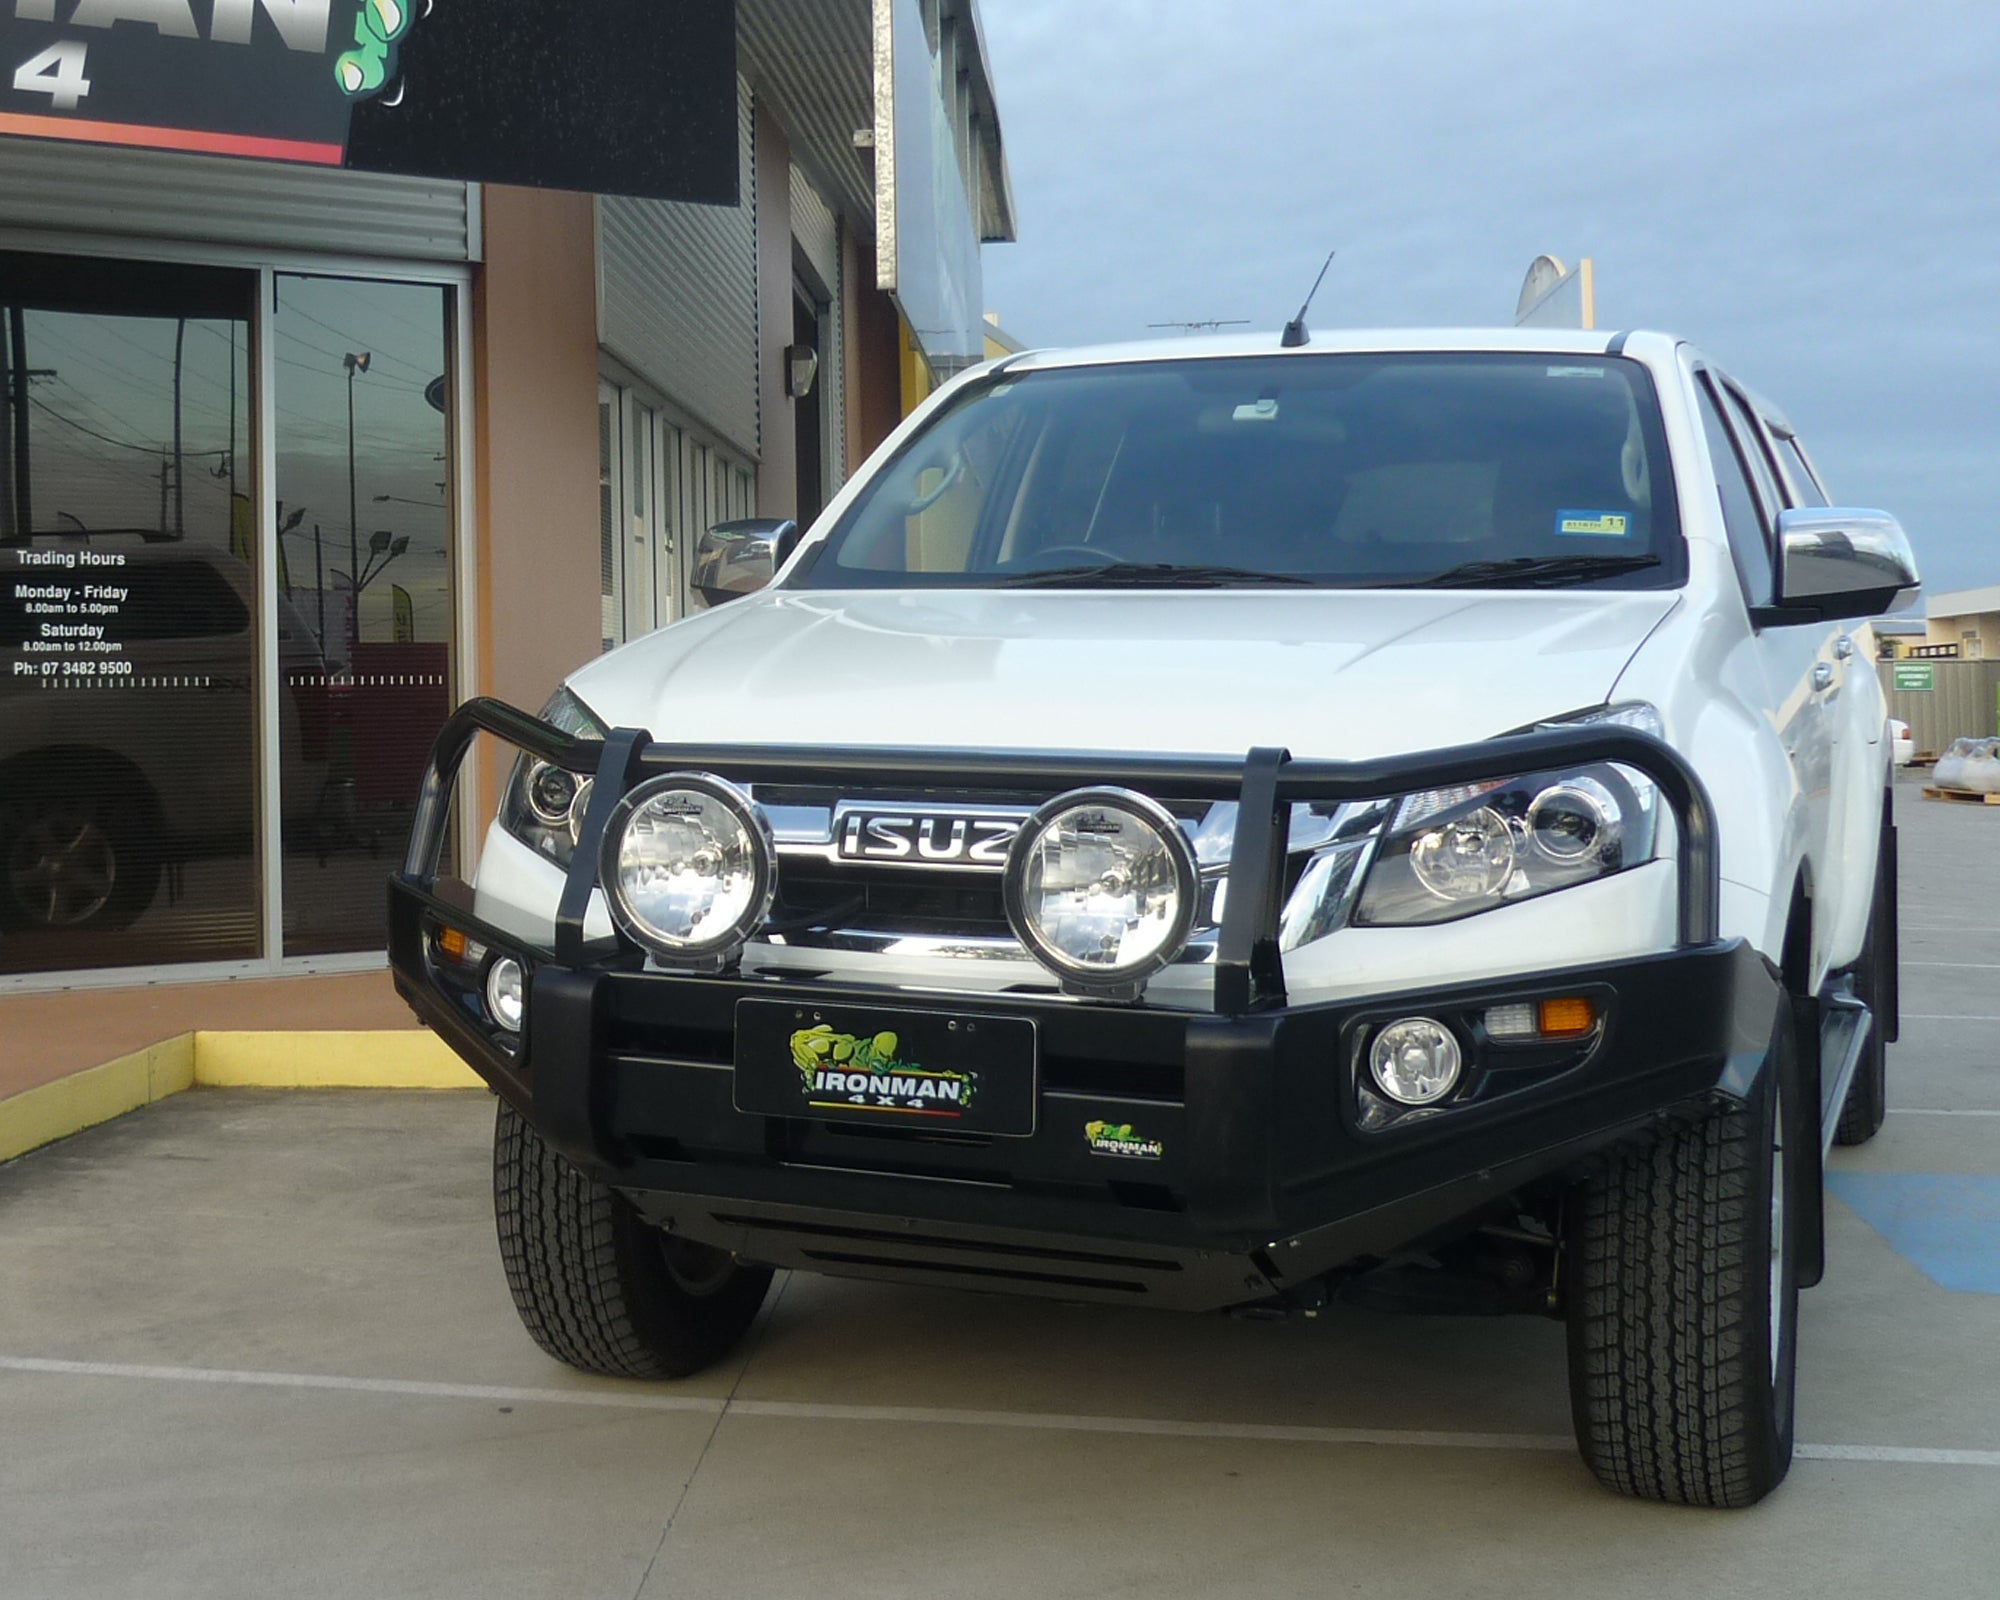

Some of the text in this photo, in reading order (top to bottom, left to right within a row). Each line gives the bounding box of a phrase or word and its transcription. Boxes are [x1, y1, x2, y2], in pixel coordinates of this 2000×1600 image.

[17, 550, 126, 569] Trading Hours
[15, 584, 72, 602] Monday
[84, 585, 129, 602] Friday
[25, 603, 119, 616] 8.00am to 5.00pm
[41, 623, 104, 640] Saturday
[23, 641, 122, 654] 8.00am to 12.00pm
[14, 661, 132, 676] Ph: 07 3482 9500
[844, 815, 1019, 861] ISUZ
[815, 1071, 960, 1100] IRONMAN
[1096, 1139, 1158, 1153] IRONMAN
